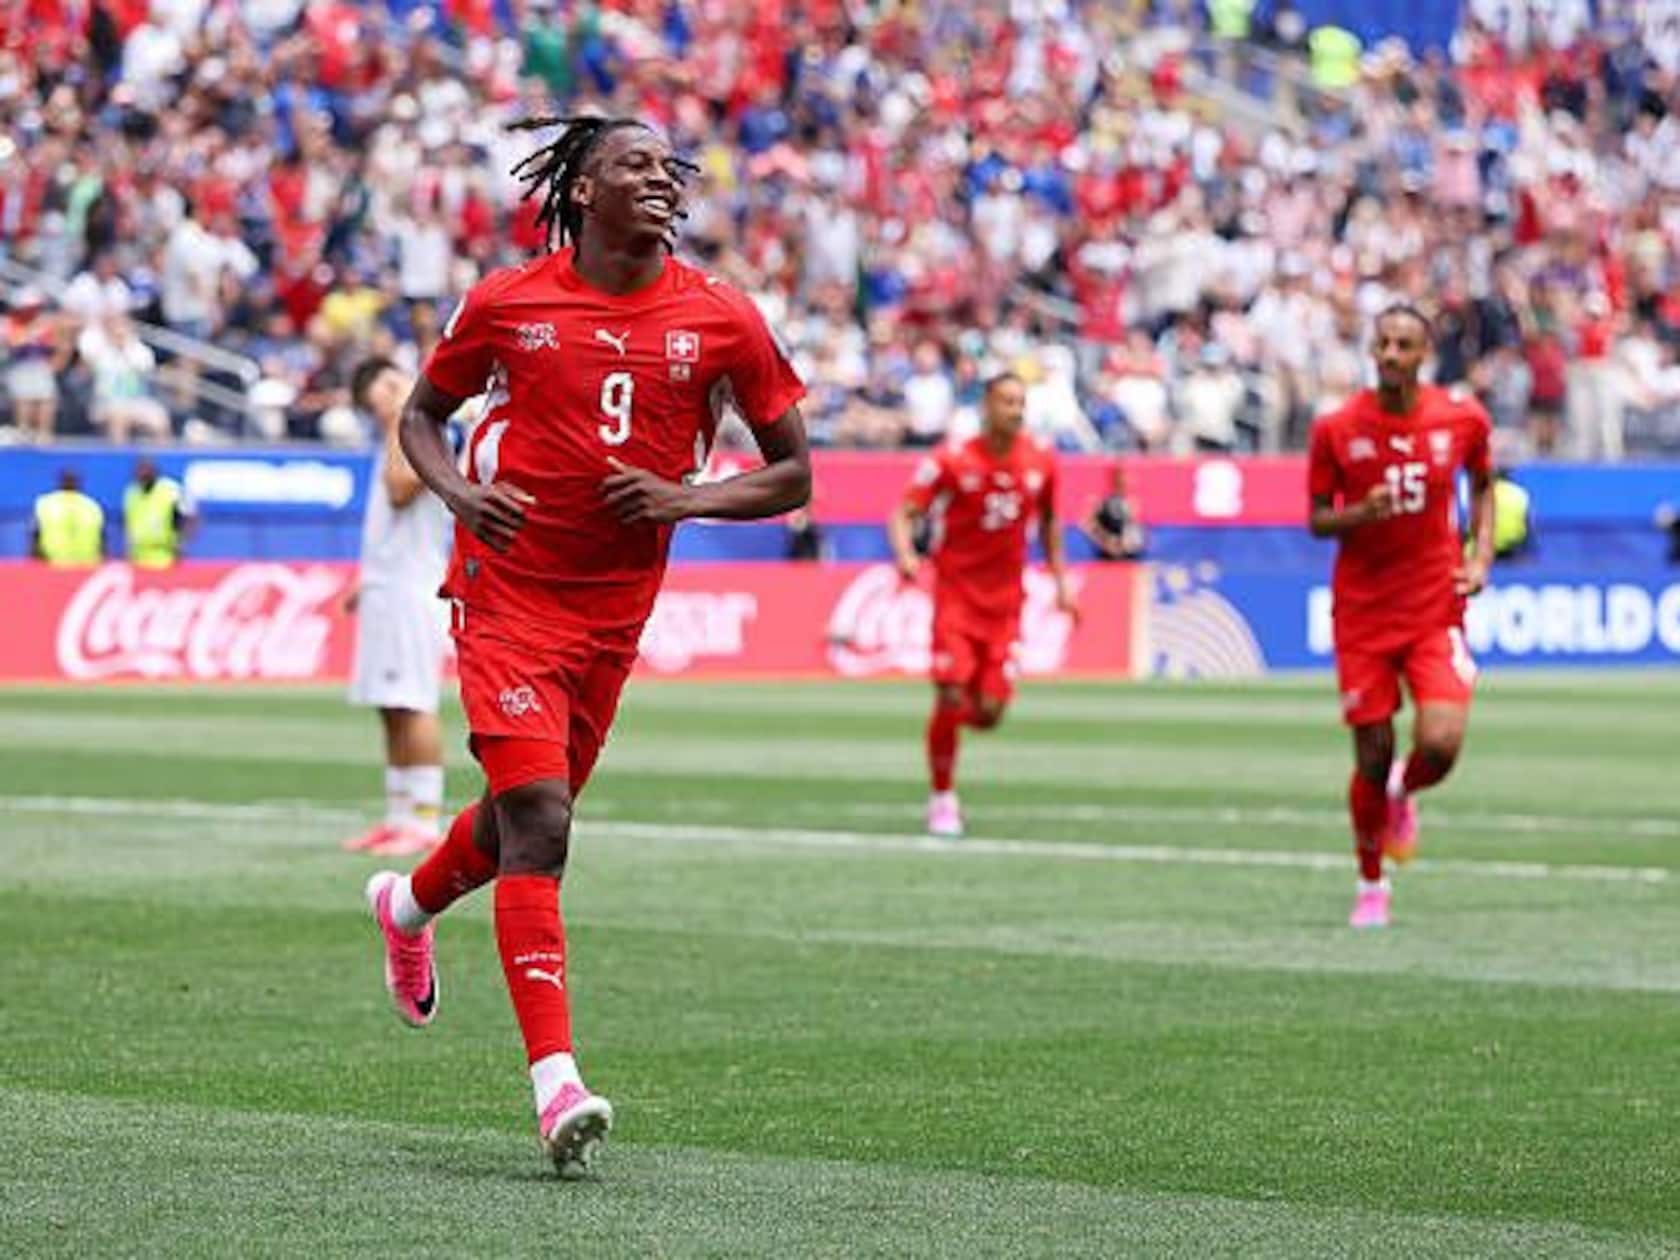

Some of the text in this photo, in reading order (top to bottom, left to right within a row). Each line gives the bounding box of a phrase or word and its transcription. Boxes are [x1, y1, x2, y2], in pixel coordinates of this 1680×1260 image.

[599, 372, 634, 445] 9
[1385, 462, 1427, 514] 15
[56, 562, 342, 679] Coca-Cola
